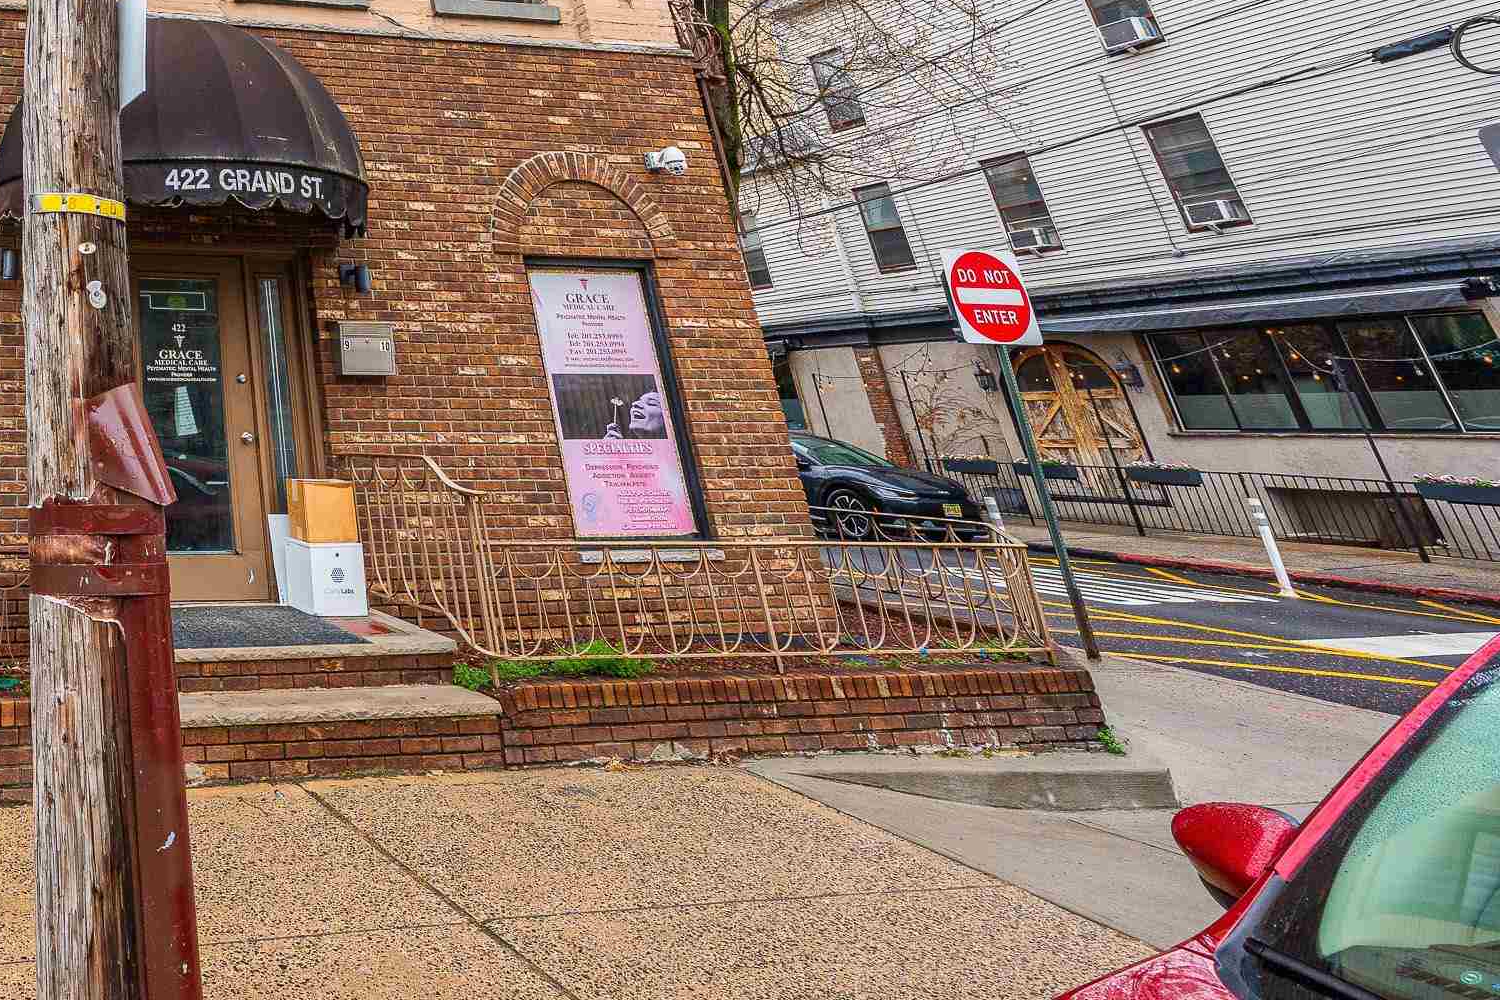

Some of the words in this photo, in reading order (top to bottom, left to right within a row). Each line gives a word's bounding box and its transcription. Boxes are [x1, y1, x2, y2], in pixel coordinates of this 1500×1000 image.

[164, 169, 210, 191] 422
[219, 169, 294, 195] GRAND
[300, 174, 325, 200] ST.
[957, 268, 977, 283] DO
[984, 270, 1011, 284] NOT
[565, 293, 610, 304] GRACE
[973, 309, 1019, 325] ENTER
[171, 323, 186, 332] 422
[344, 340, 350, 350] 9
[381, 341, 390, 351] 10
[159, 349, 203, 360] GRACE
